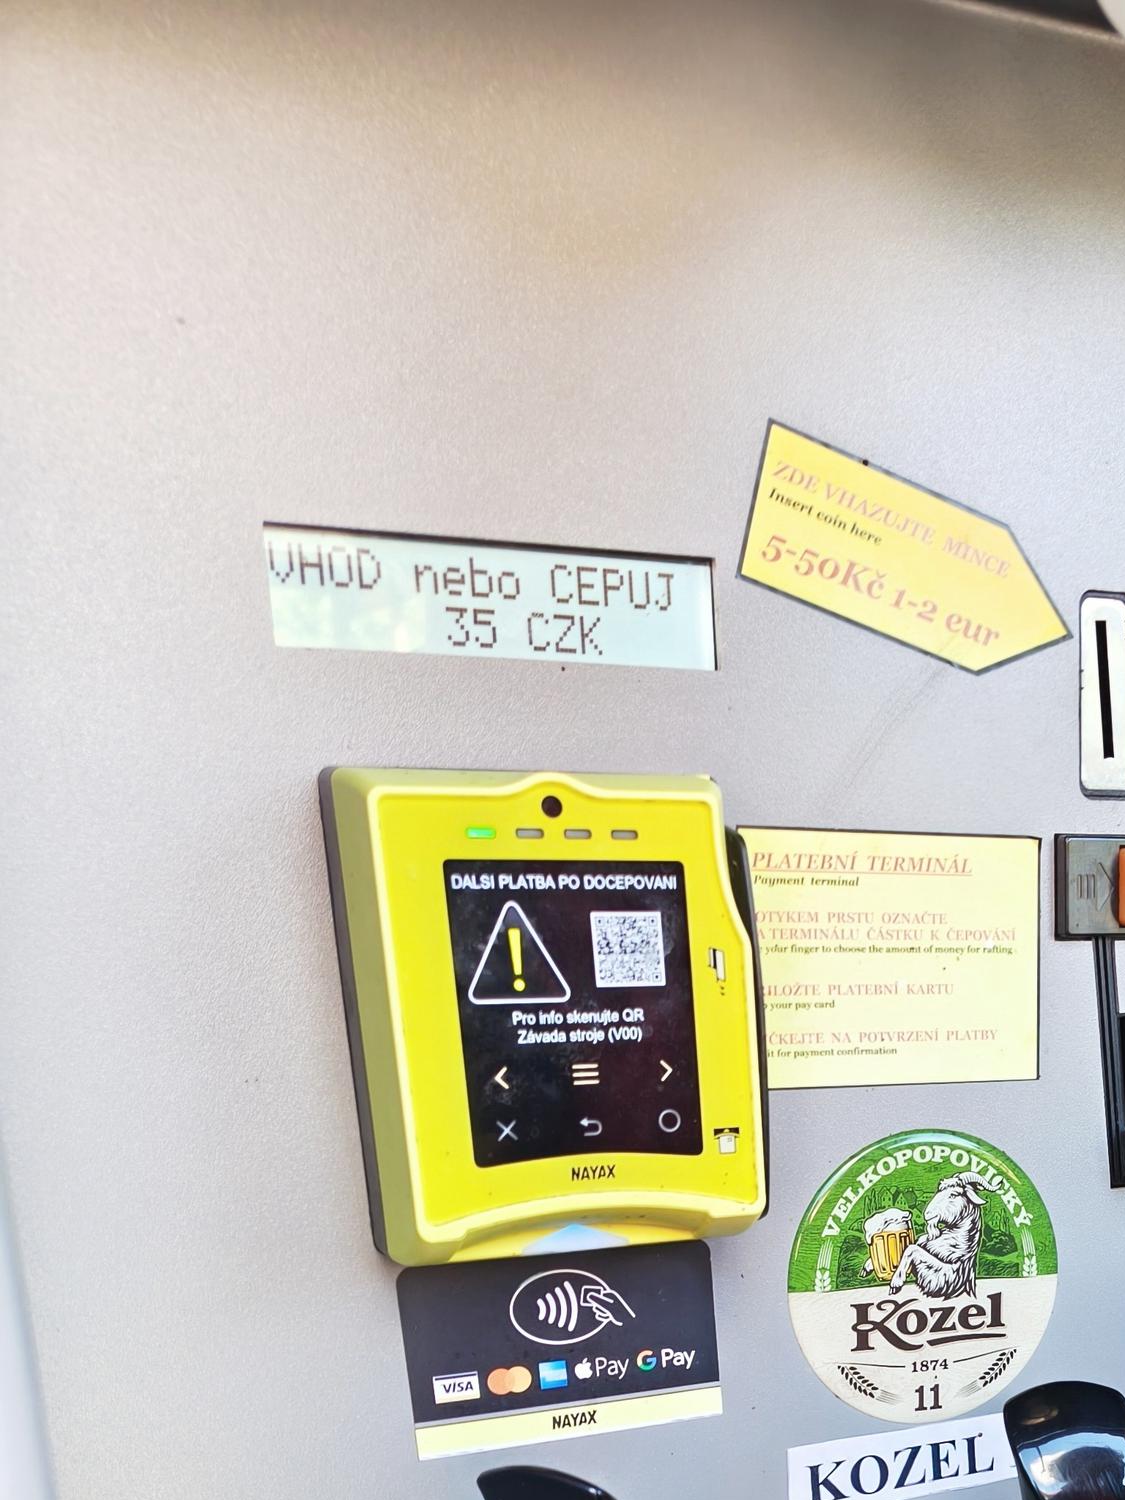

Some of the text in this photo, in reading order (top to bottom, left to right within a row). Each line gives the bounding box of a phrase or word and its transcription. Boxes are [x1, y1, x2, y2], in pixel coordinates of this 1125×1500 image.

[768, 487, 883, 546] Insert coin here
[772, 460, 1011, 579] ZDE VHAZUJTE MINCE
[268, 541, 675, 611] VHOD nebo CEPUJ
[761, 534, 1001, 648] 5-50Kč 1-2 eur
[445, 607, 603, 656] 35 CZK
[751, 851, 973, 875] PLATEBNÍ TERMINÁL
[450, 873, 678, 891] DALSI PLATBA PO DOCEPOVANI
[753, 874, 859, 888] Payment terminal
[756, 911, 948, 925] OTYKEM PRSTU OZNAČTE
[771, 927, 860, 941] TERMINÁLU
[866, 927, 923, 941] ČÁSTKU
[930, 929, 939, 941] K
[765, 945, 787, 955] your
[791, 944, 819, 955] finger
[822, 945, 832, 953] to
[833, 944, 866, 953] choose
[868, 944, 884, 953] the
[885, 945, 921, 953] amount
[923, 944, 934, 953] of
[935, 946, 965, 956] money
[967, 944, 980, 953] for
[828, 981, 899, 996] PLATEBNÍ
[907, 983, 954, 995] KARTU
[771, 1003, 792, 1011] your
[795, 1003, 810, 1011] pay
[814, 1000, 835, 1008] card
[512, 1008, 645, 1028] Pro info skenujte QR
[517, 1028, 568, 1044] Závada
[569, 1029, 605, 1045] stroje
[768, 1031, 825, 1045] ČKEJTE
[831, 1032, 851, 1043] NA
[777, 1048, 792, 1057] for
[793, 1049, 835, 1059] payment
[836, 1046, 898, 1056] confirmation
[571, 1164, 616, 1182] NAYAX
[821, 1145, 1034, 1239] VELKOPOPOVICKÝ
[850, 1291, 1006, 1352] Kozel
[442, 1381, 474, 1395] VISA
[594, 1357, 630, 1380] Pay
[660, 1348, 695, 1370] Pay
[911, 1358, 949, 1373] 1874
[914, 1383, 943, 1412] 11
[552, 1409, 598, 1430] NAYAX
